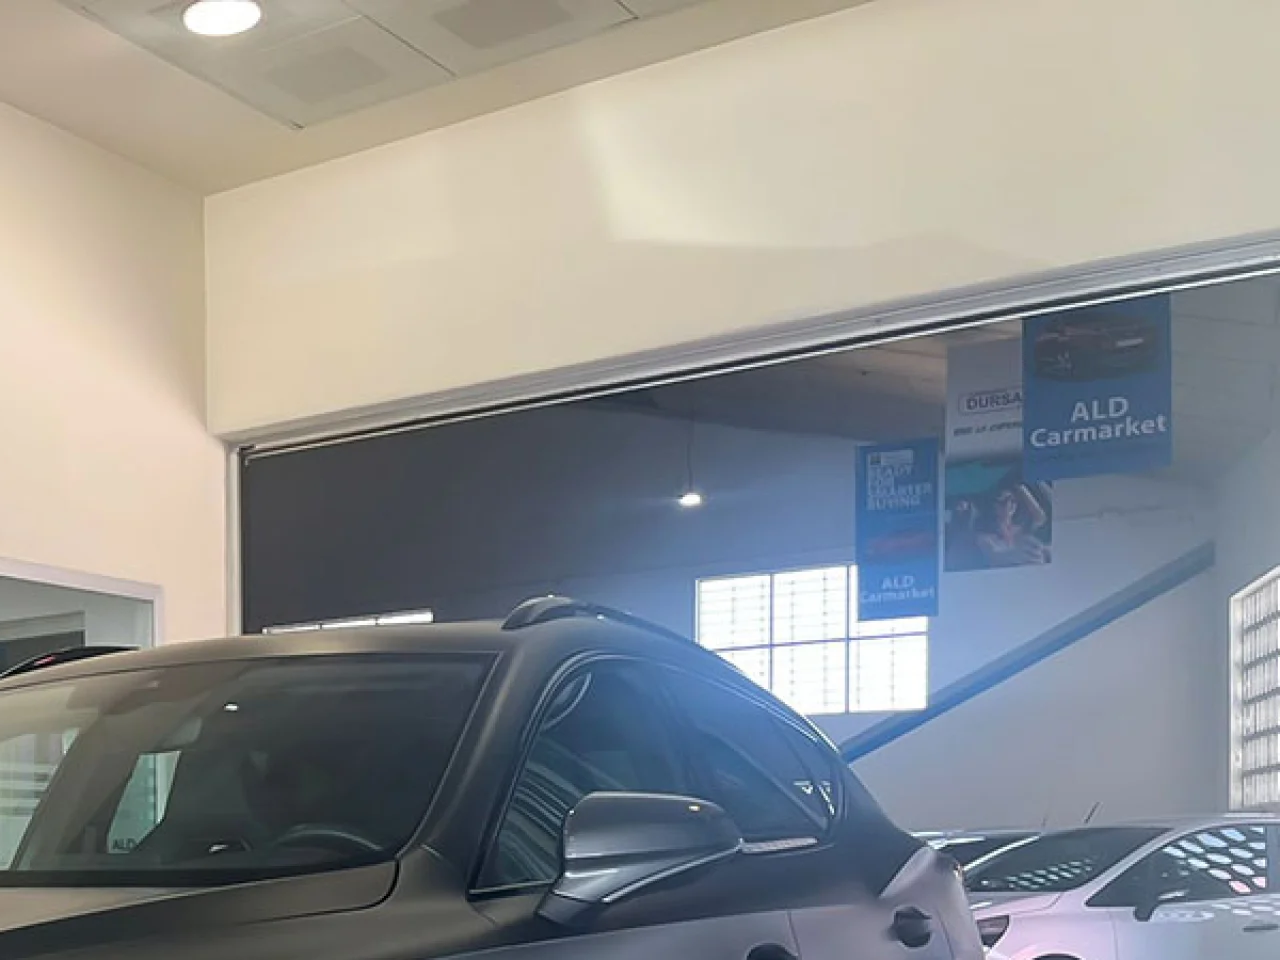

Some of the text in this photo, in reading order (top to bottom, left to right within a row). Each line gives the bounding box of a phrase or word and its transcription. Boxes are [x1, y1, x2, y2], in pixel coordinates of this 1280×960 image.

[1071, 396, 1129, 422] ALD
[1030, 414, 1167, 447] Carmarket
[881, 575, 914, 590] ALD
